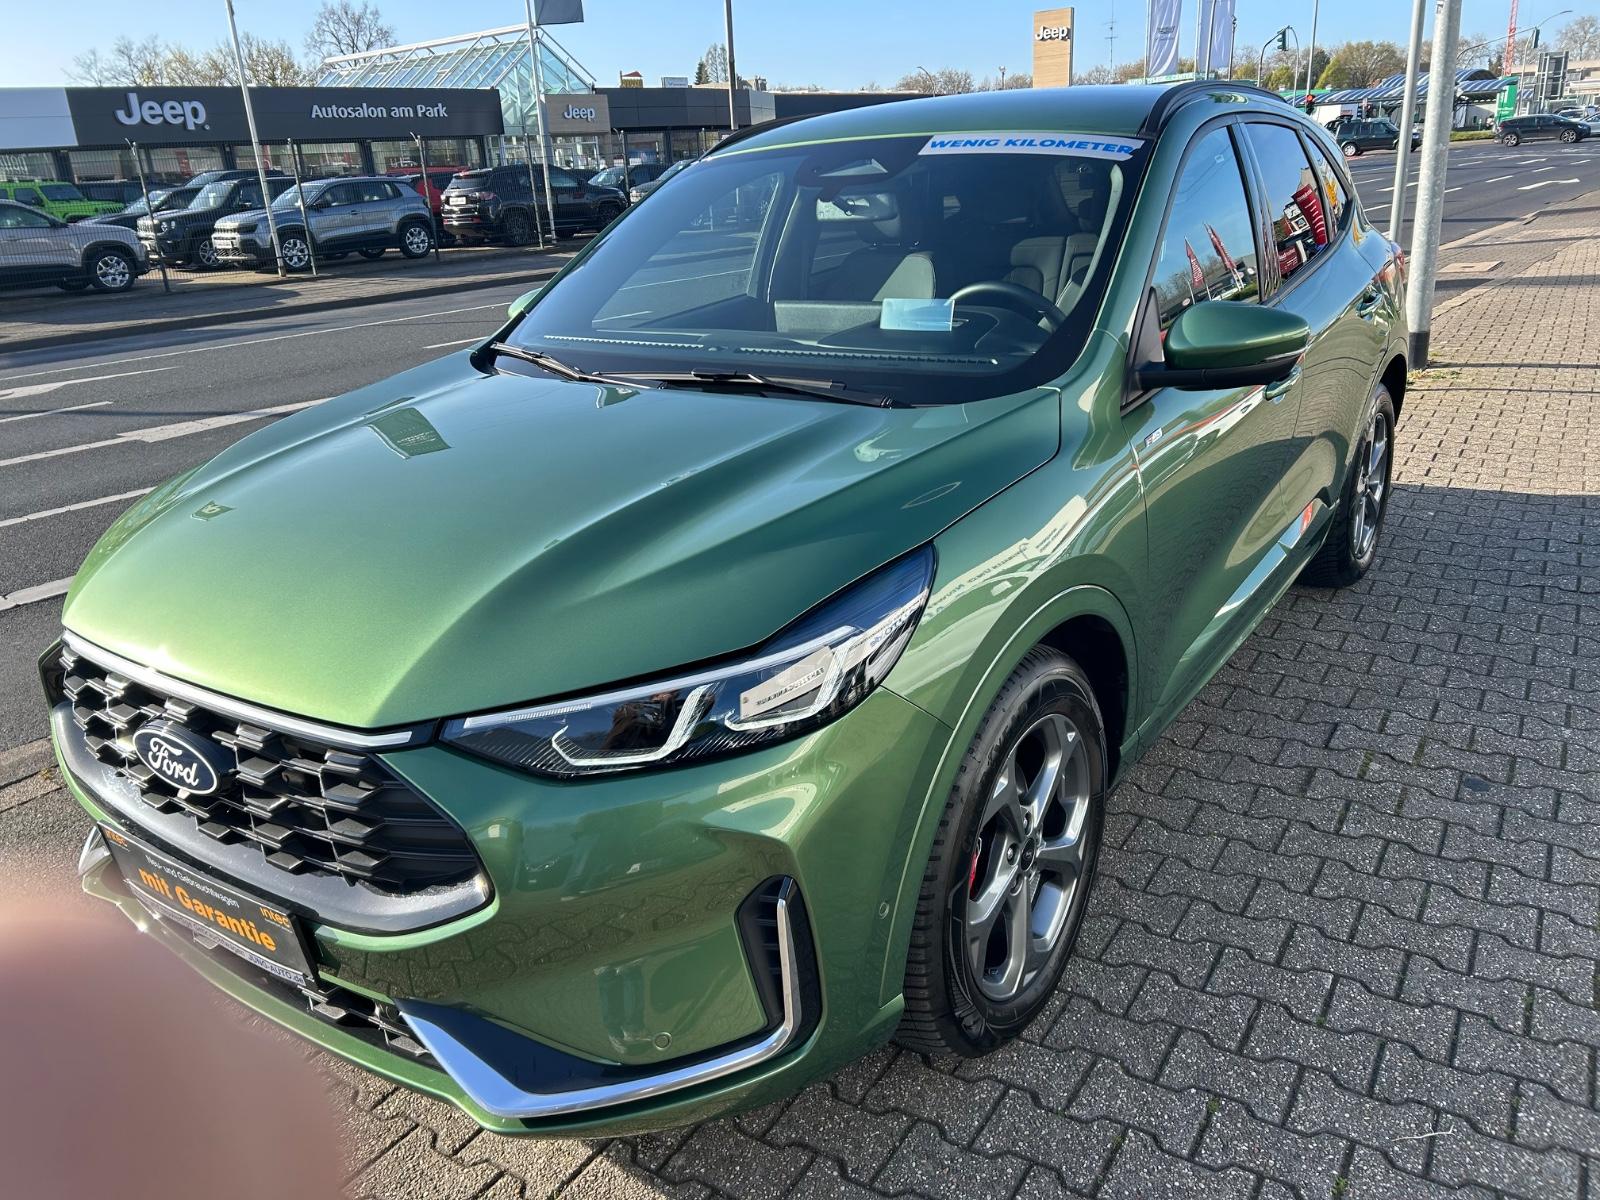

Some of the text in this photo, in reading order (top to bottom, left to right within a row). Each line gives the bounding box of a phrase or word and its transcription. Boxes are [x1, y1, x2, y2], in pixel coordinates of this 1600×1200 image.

[1034, 25, 1068, 40] Jeep
[114, 92, 206, 130] Jeep
[311, 103, 448, 119] Autosalon am Park
[563, 104, 596, 122] Jeep
[929, 138, 1137, 154] WENIG KILOMETER
[147, 736, 200, 787] Ford
[137, 867, 174, 900] mit
[174, 885, 277, 953] Garantie
[258, 906, 292, 929] intec
